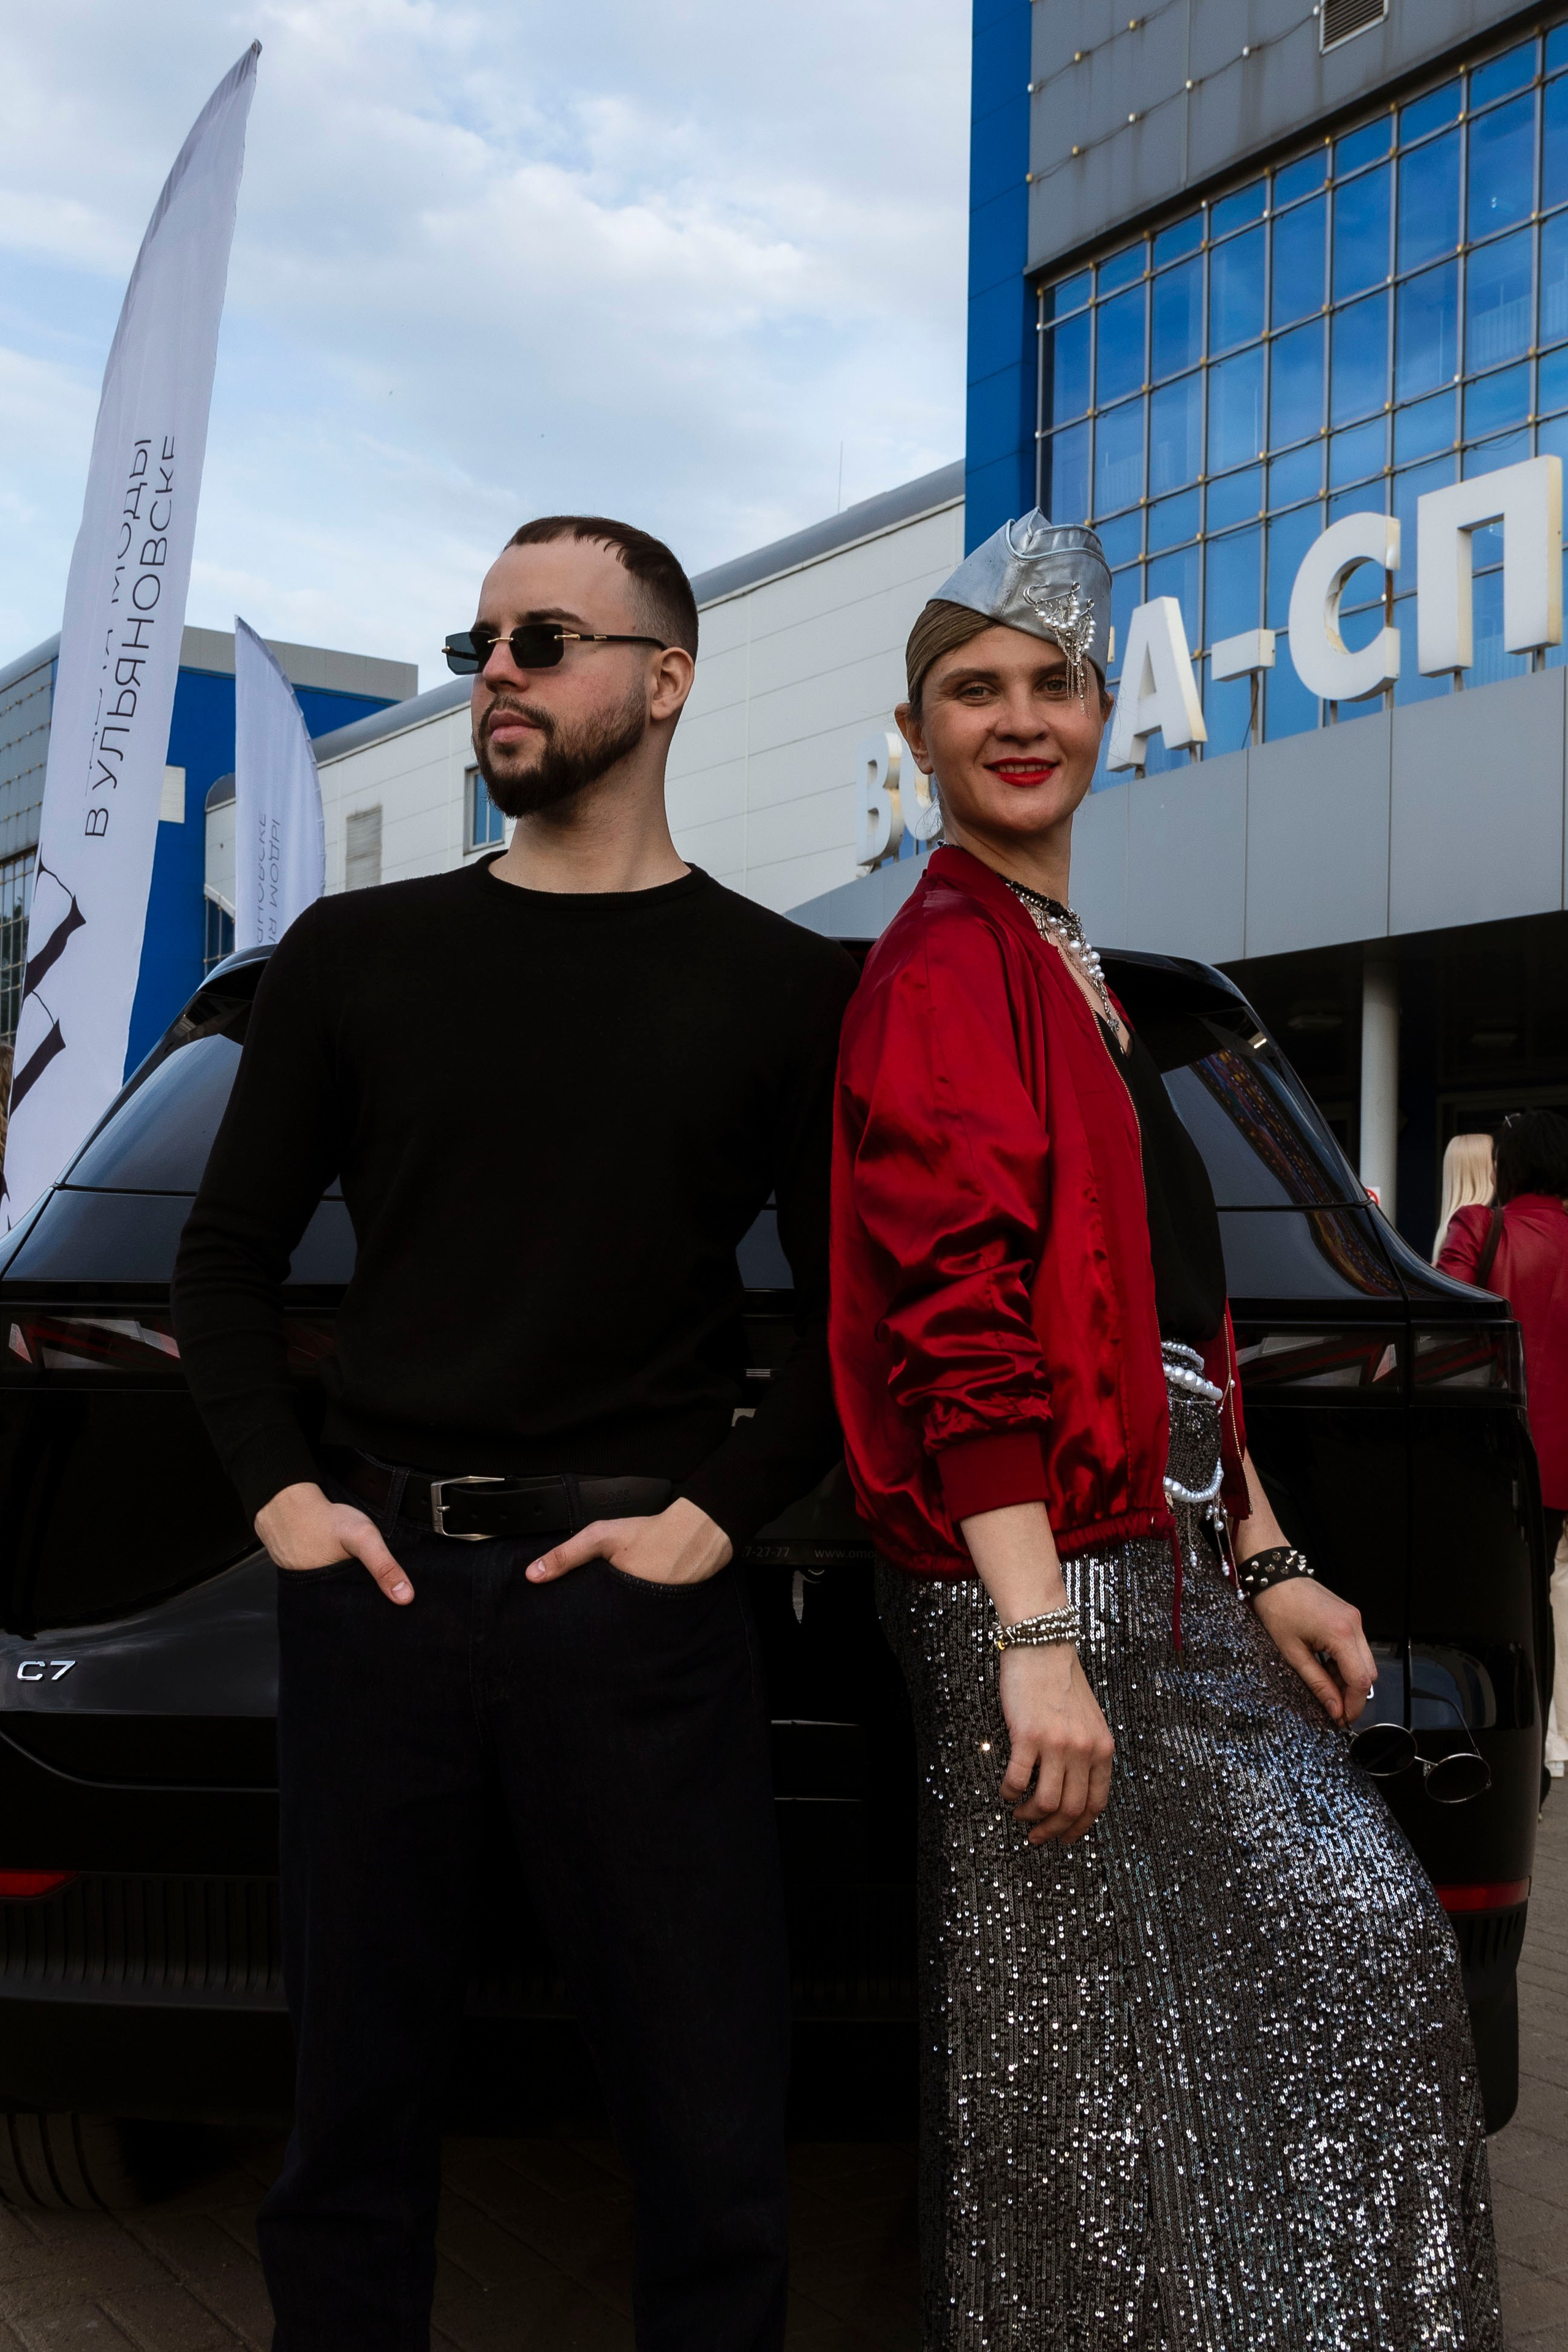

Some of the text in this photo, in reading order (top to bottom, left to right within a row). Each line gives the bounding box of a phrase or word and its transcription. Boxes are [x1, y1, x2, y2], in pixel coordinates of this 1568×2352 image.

[92, 435, 176, 791] УЛЬЯНОВСКЕ
[85, 808, 110, 837] В
[742, 1545, 875, 1558] 7-27-77 www.omo
[17, 1660, 77, 1681] C7
